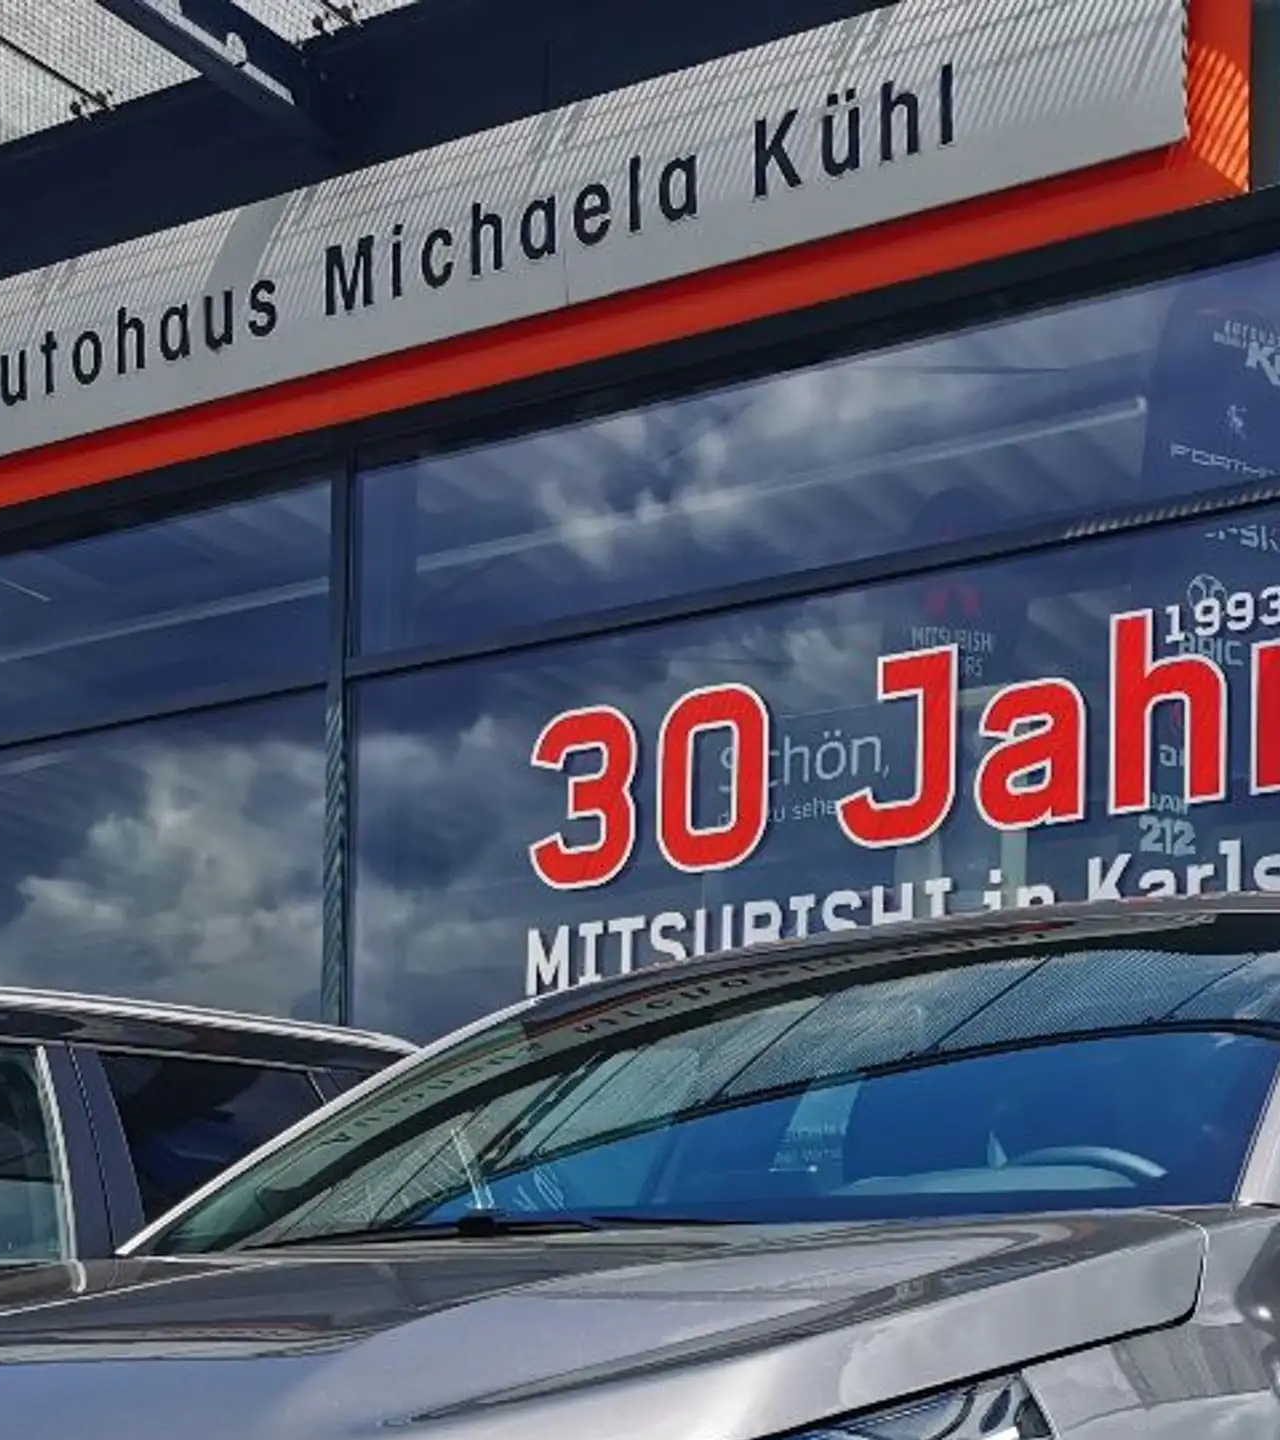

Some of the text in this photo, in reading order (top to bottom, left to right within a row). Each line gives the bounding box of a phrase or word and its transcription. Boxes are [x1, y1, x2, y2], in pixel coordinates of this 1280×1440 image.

[324, 152, 699, 316] Michaela
[752, 64, 958, 198] Kühl
[529, 683, 770, 889] 30
[1139, 815, 1196, 856] 212
